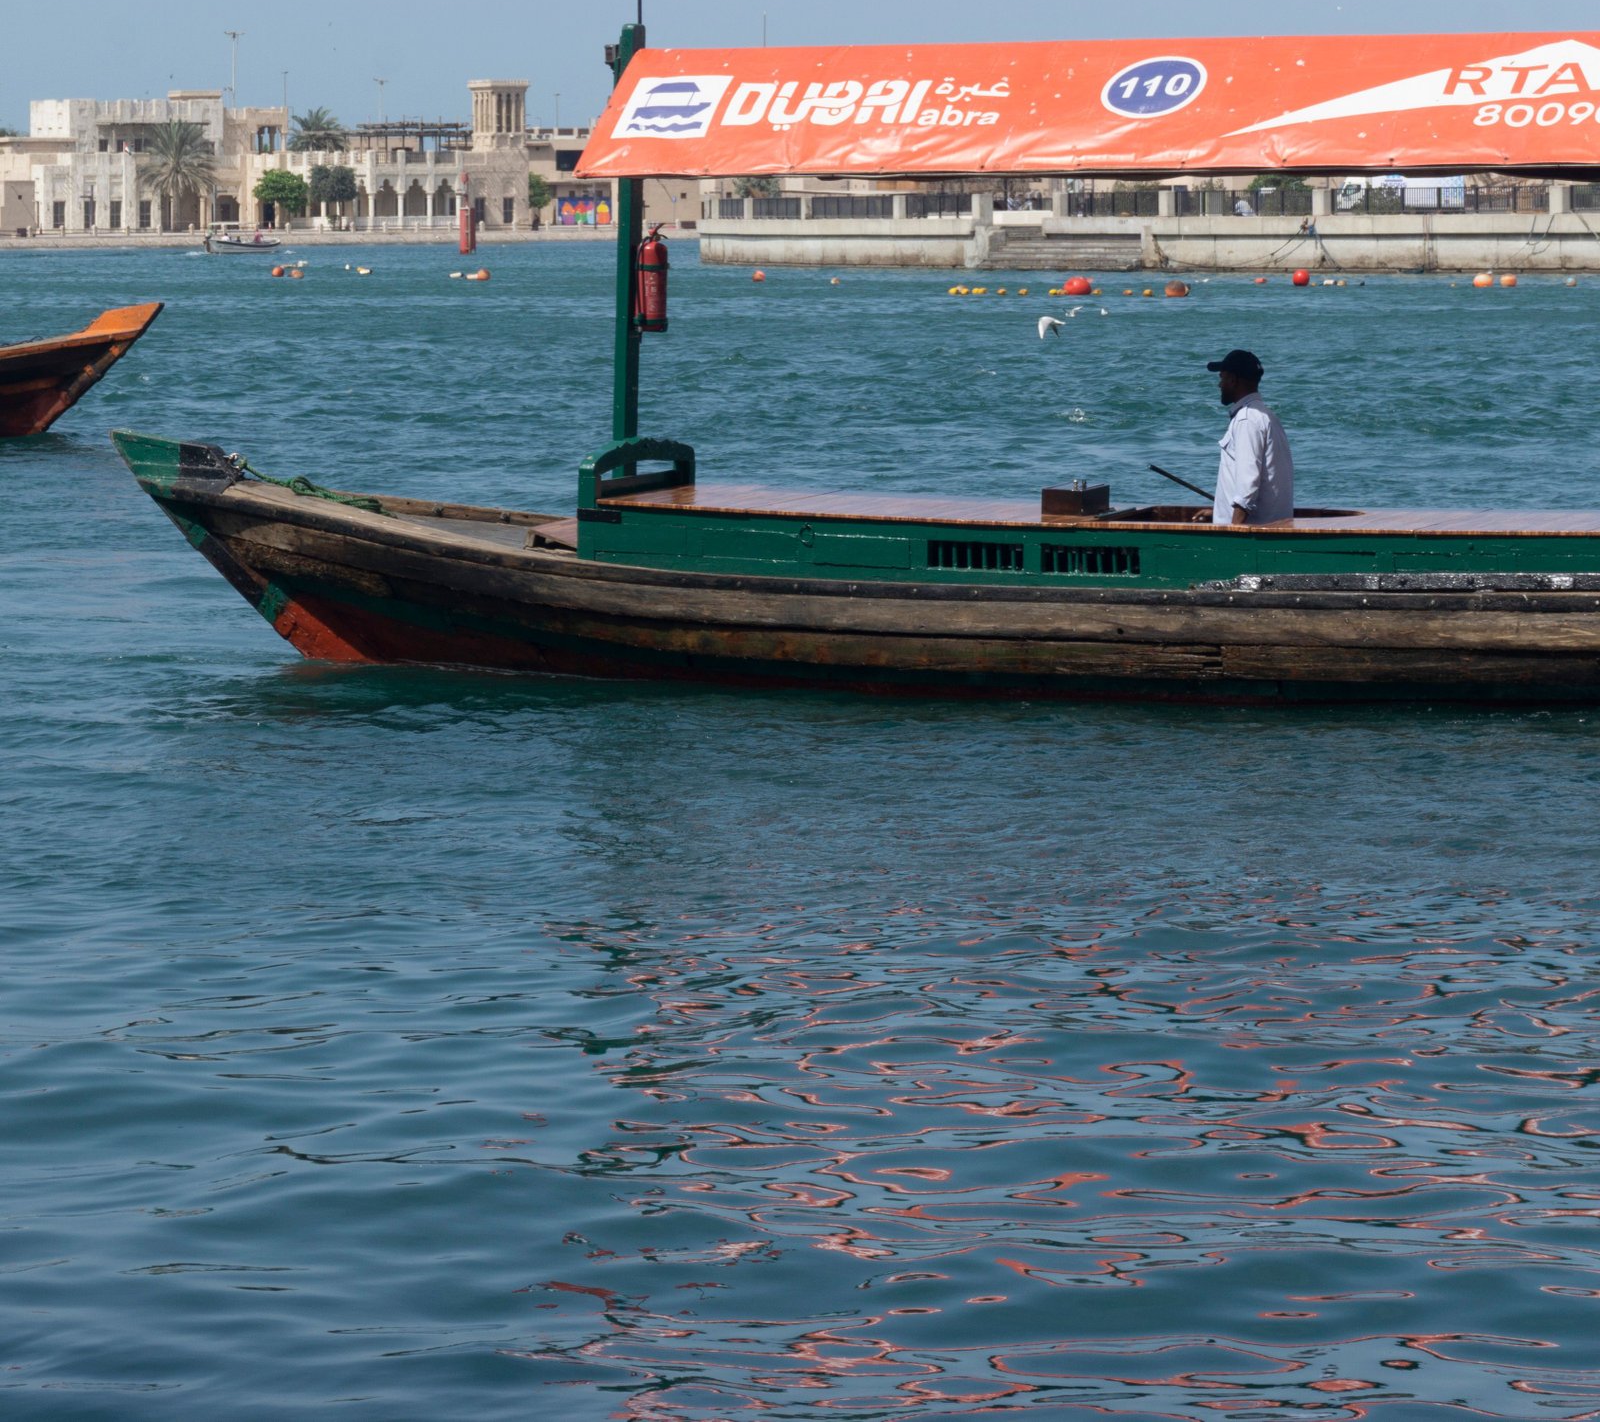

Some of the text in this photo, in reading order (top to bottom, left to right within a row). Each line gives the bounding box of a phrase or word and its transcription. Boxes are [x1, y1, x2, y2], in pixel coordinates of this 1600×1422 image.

[1119, 73, 1192, 98] 110
[1442, 62, 1591, 96] RTA
[720, 79, 933, 131] DUBAI
[917, 105, 1000, 127] abra
[1472, 101, 1600, 128] 8009
